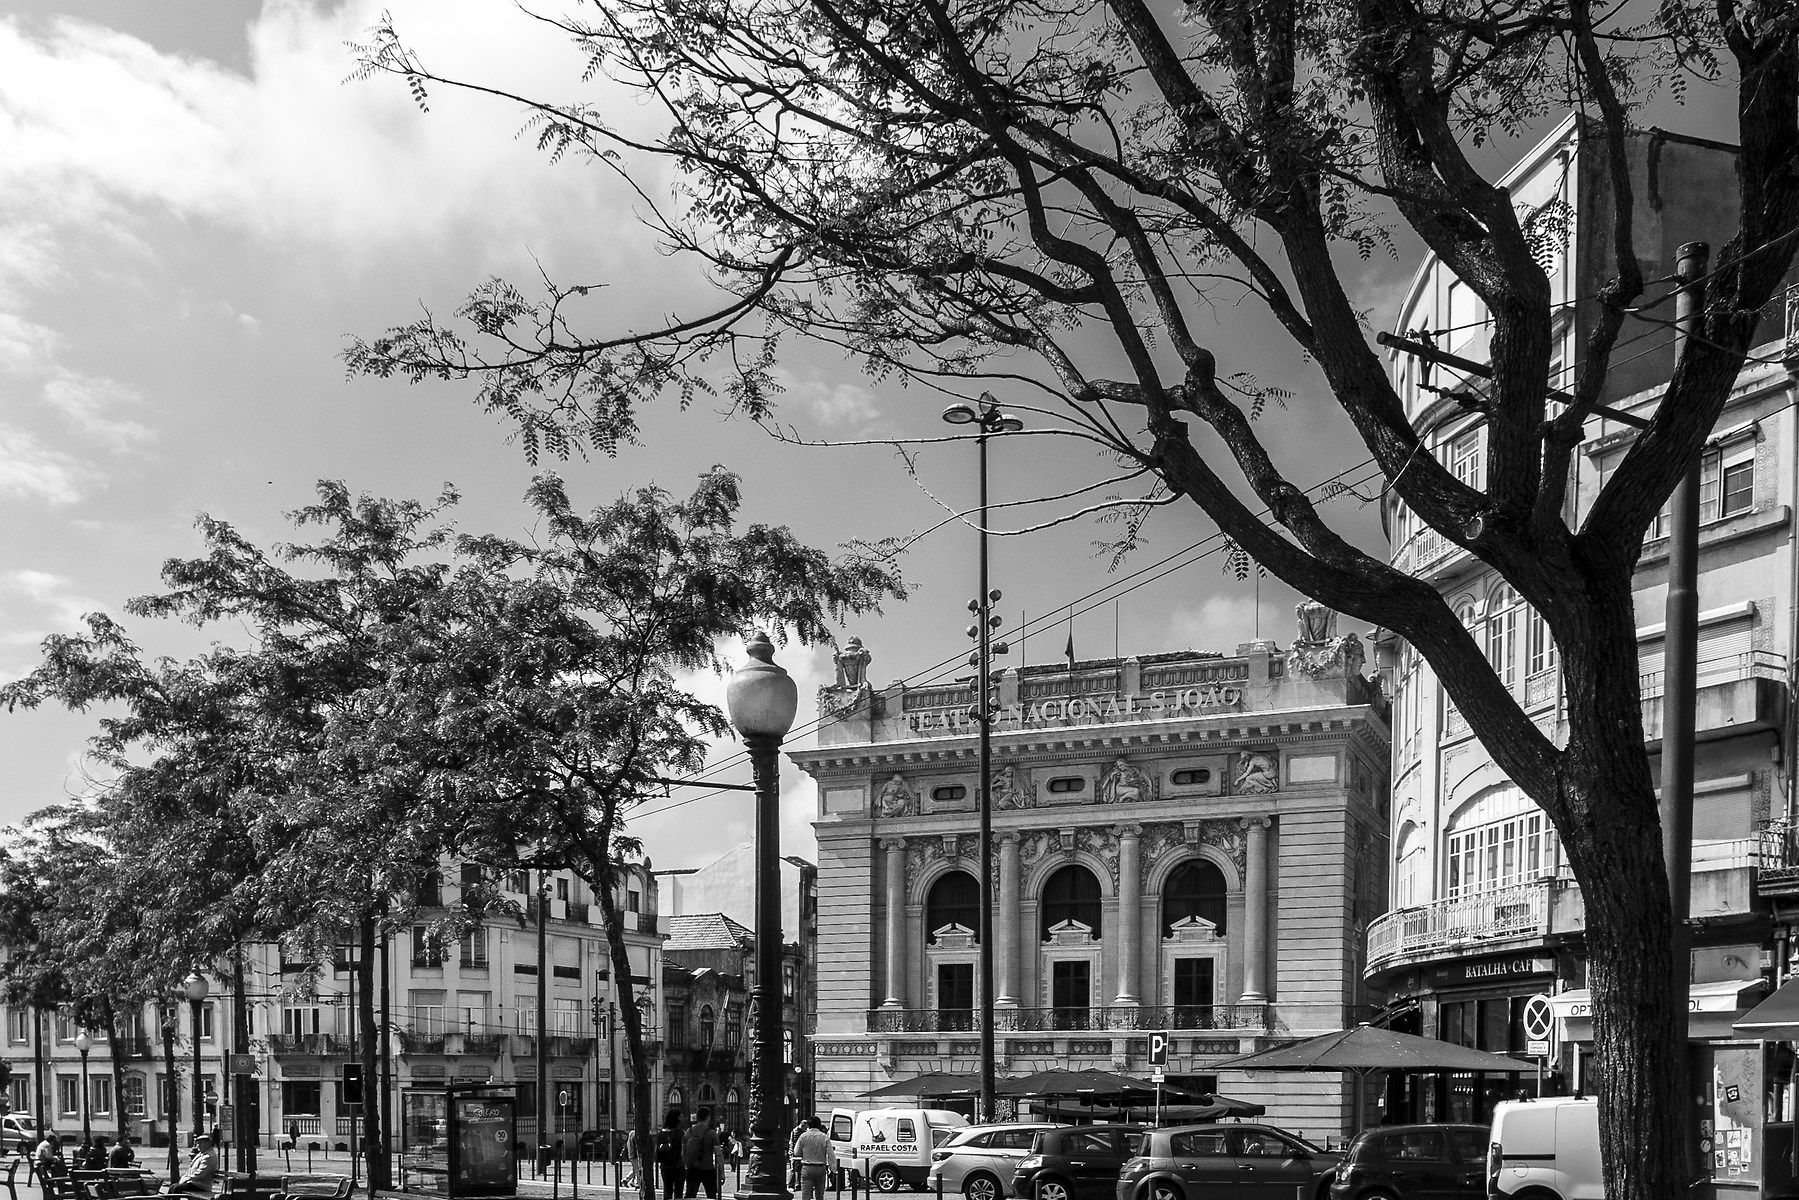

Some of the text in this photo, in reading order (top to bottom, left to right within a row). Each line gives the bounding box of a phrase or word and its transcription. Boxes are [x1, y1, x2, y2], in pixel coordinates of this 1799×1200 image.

[903, 704, 1002, 732] TEATO
[1007, 694, 1143, 724] NACIONAL
[1465, 962, 1507, 978] BATALHA
[1512, 959, 1532, 973] CAF
[1151, 1035, 1164, 1062] P
[860, 1144, 918, 1152] RAFAEL COSTA
